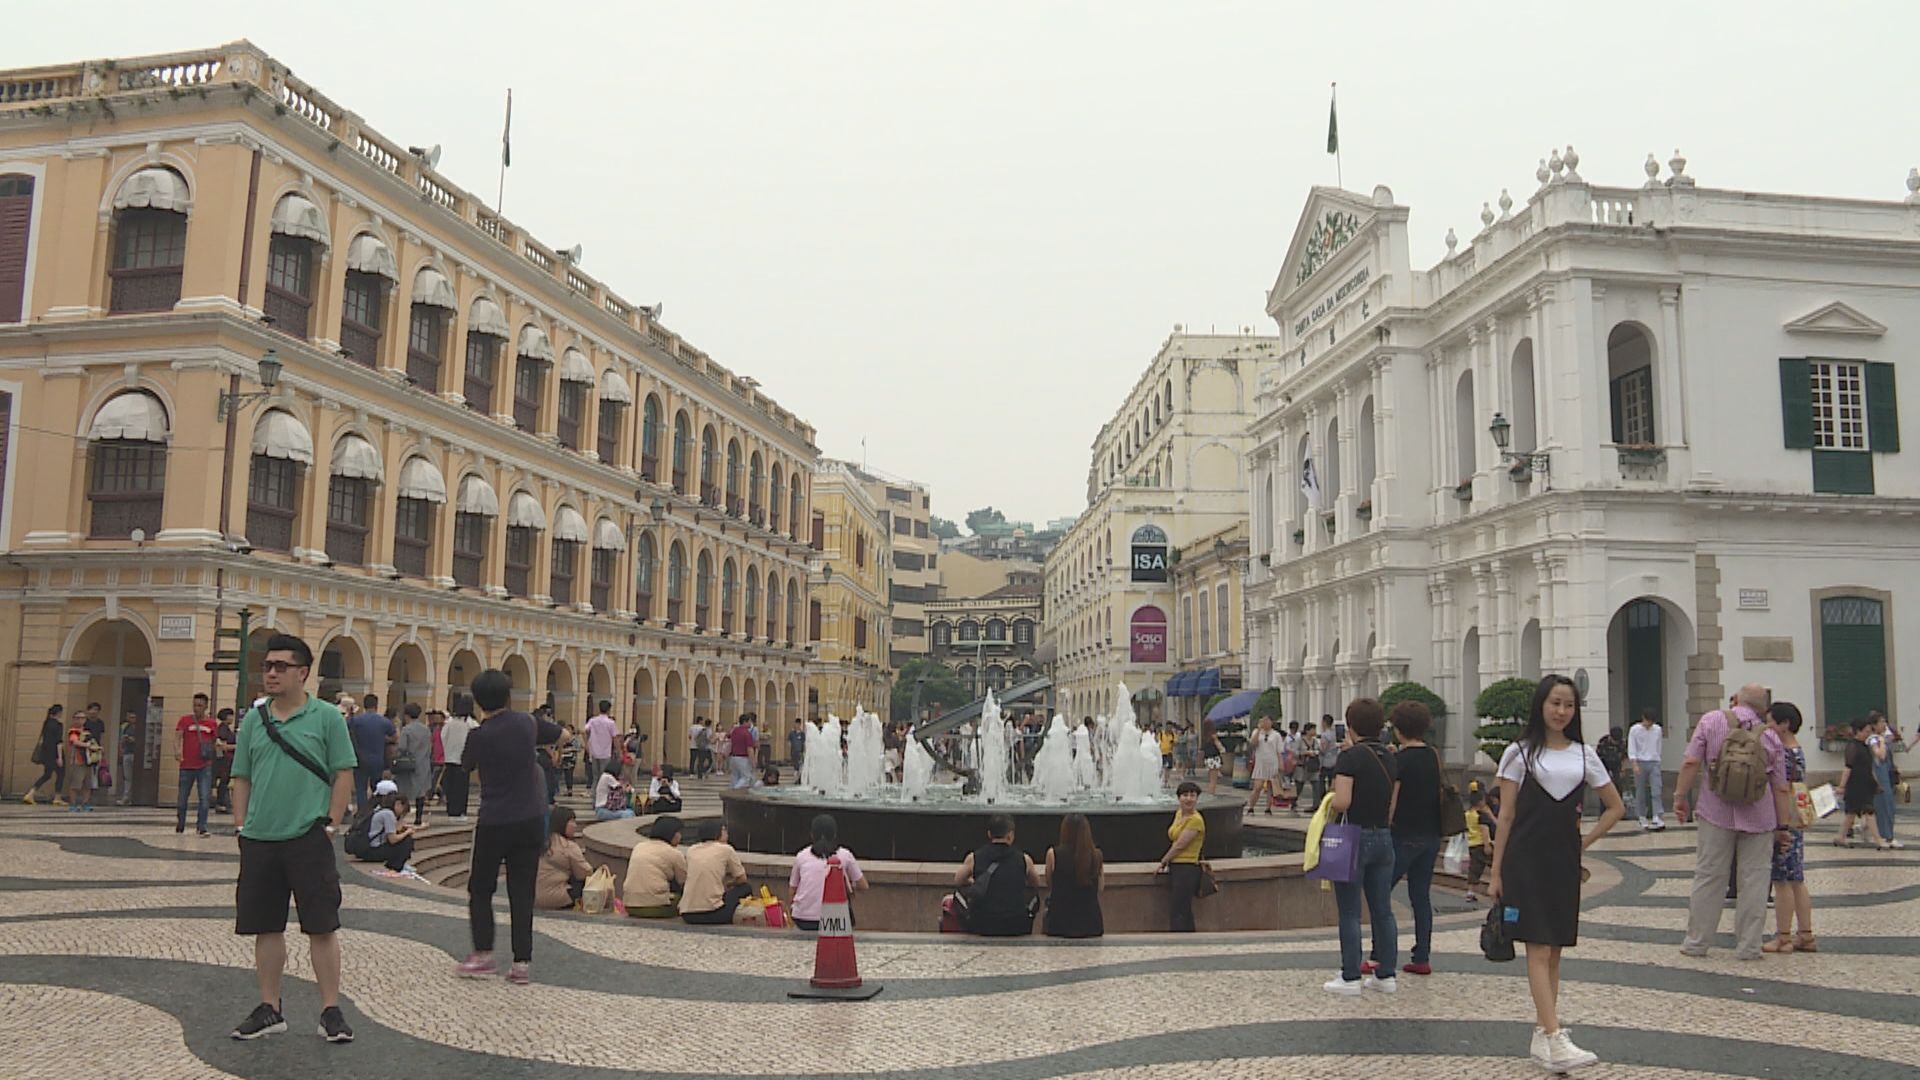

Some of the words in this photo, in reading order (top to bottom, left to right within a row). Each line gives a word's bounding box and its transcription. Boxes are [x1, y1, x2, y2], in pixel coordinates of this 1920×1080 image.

[1312, 303, 1326, 322] CASA
[1134, 554, 1165, 570] ISA
[820, 917, 846, 932] VMU
